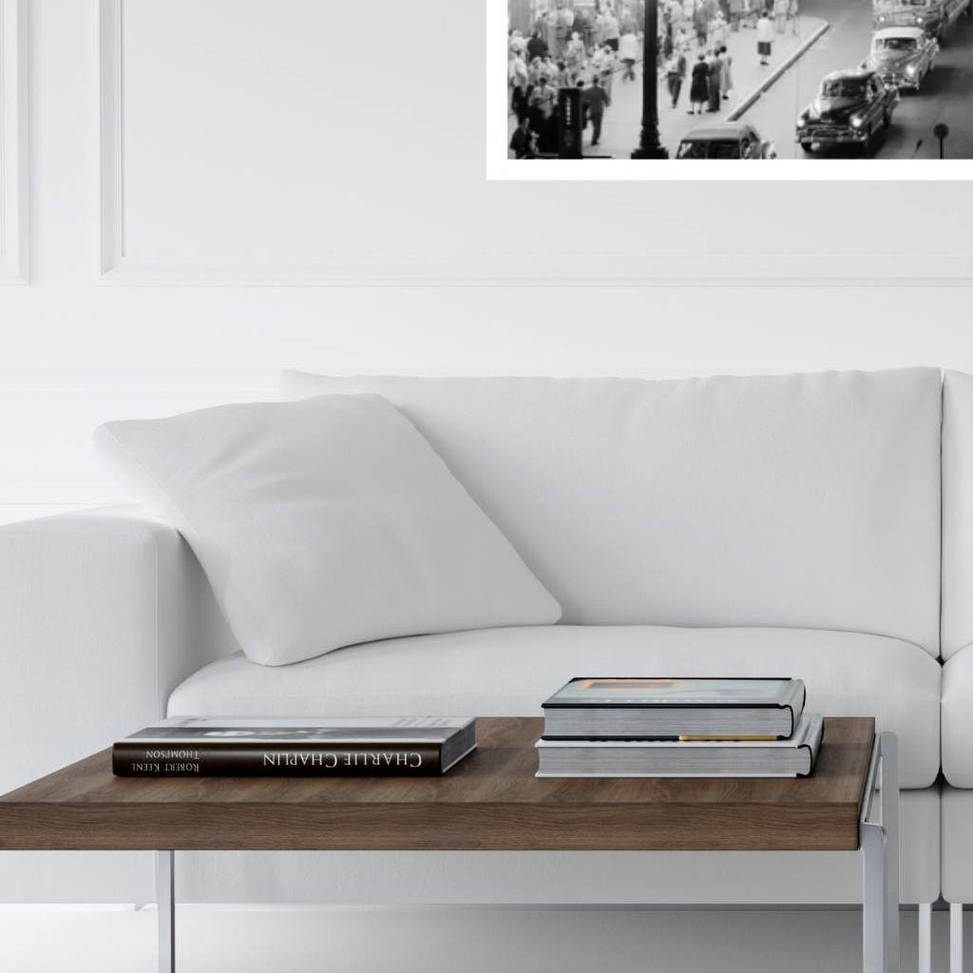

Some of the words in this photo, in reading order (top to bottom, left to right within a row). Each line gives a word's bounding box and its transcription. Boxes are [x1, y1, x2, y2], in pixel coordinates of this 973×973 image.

[146, 750, 200, 759] THOMPSON
[263, 752, 338, 768] CHAPLIN
[343, 752, 422, 768] CHARLIE
[164, 763, 199, 772] ROBERT
